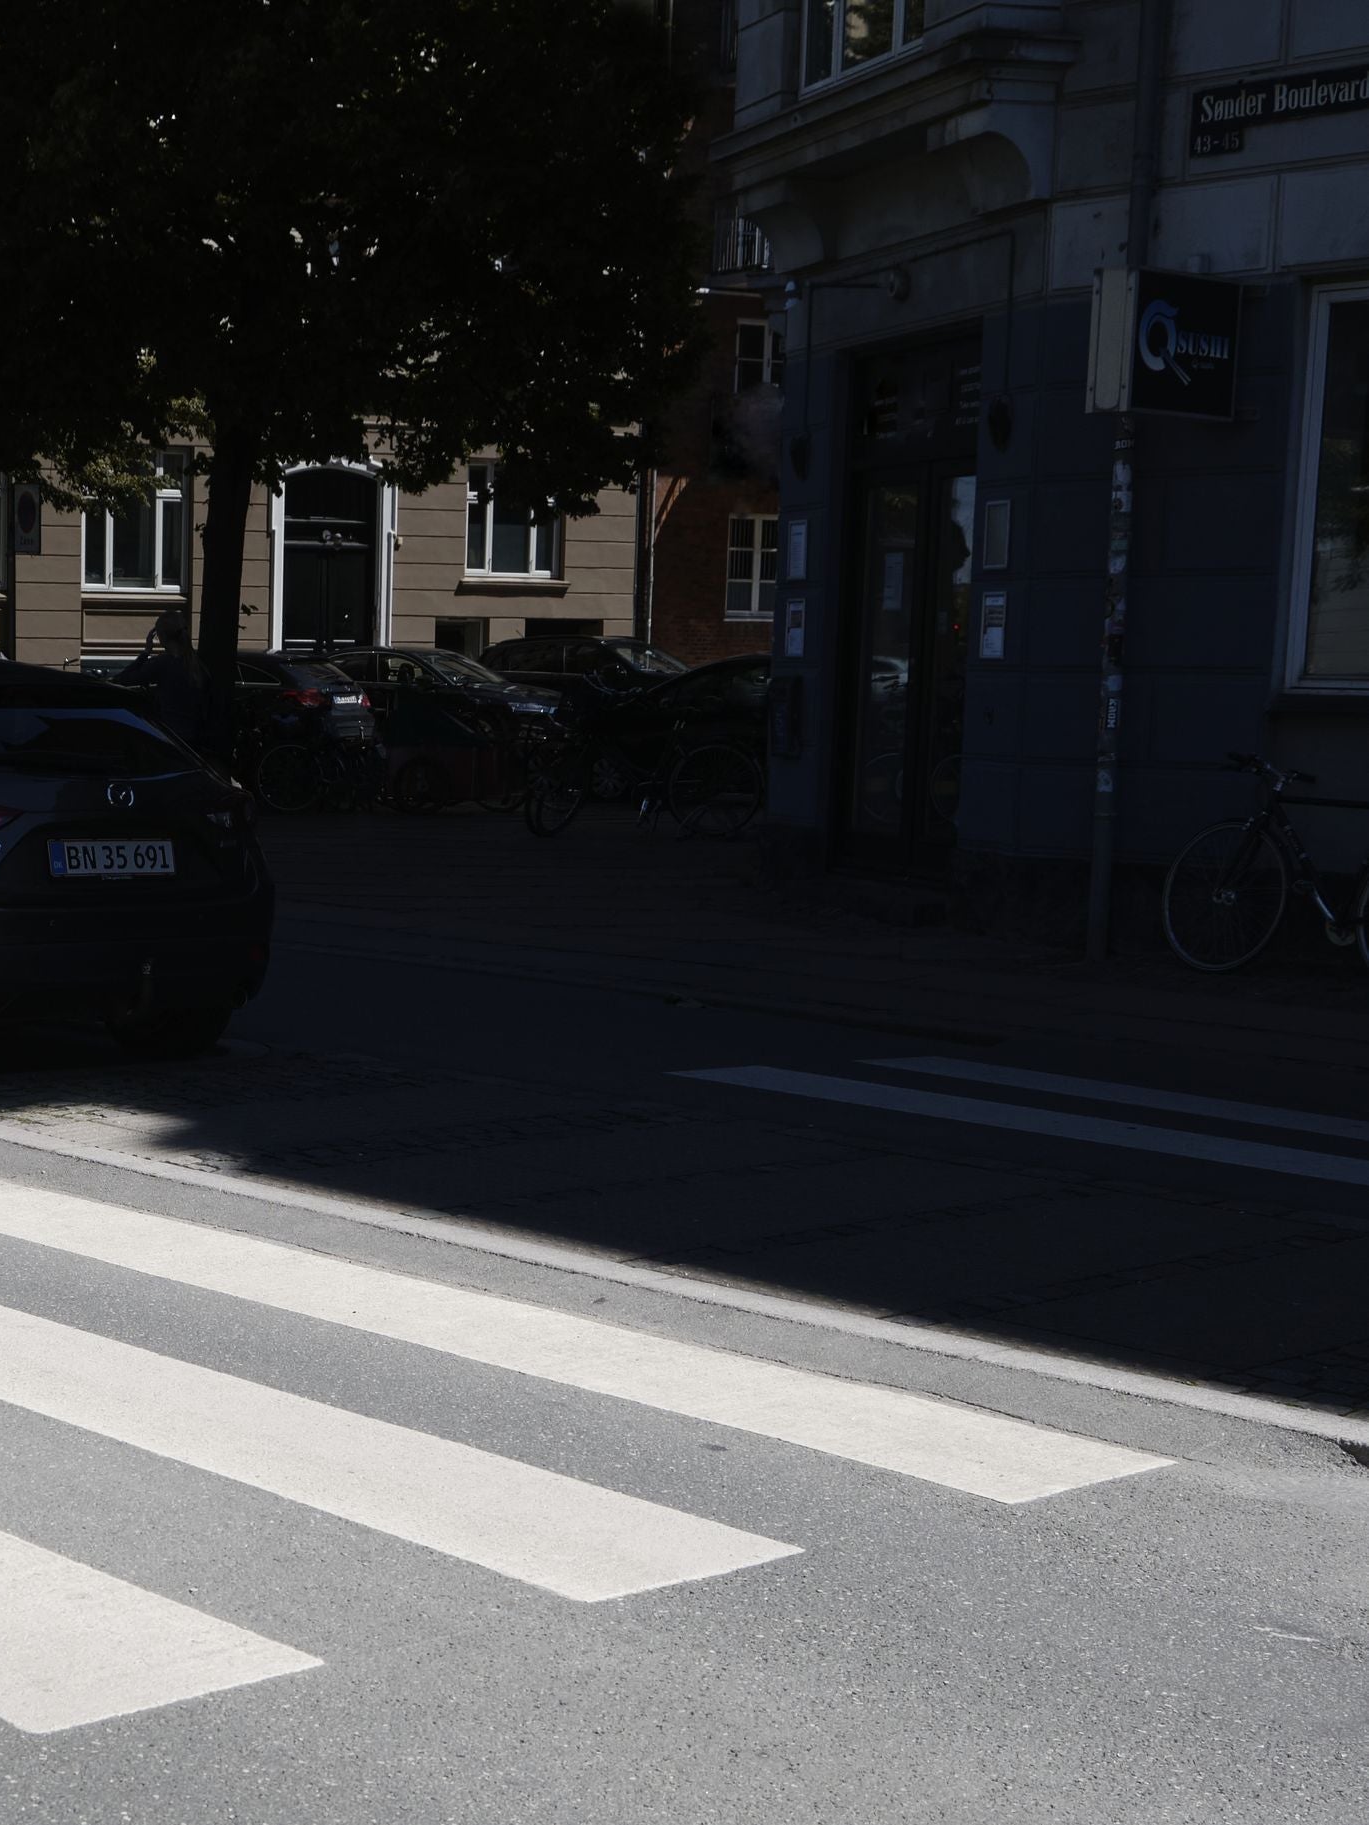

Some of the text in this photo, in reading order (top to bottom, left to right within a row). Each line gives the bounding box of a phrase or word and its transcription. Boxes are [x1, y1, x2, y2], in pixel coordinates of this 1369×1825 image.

[1200, 70, 1369, 124] Sønder Boulevard
[1193, 131, 1240, 154] 43-45
[66, 845, 97, 870] BN
[101, 845, 128, 870] 35
[133, 844, 170, 870] 691
